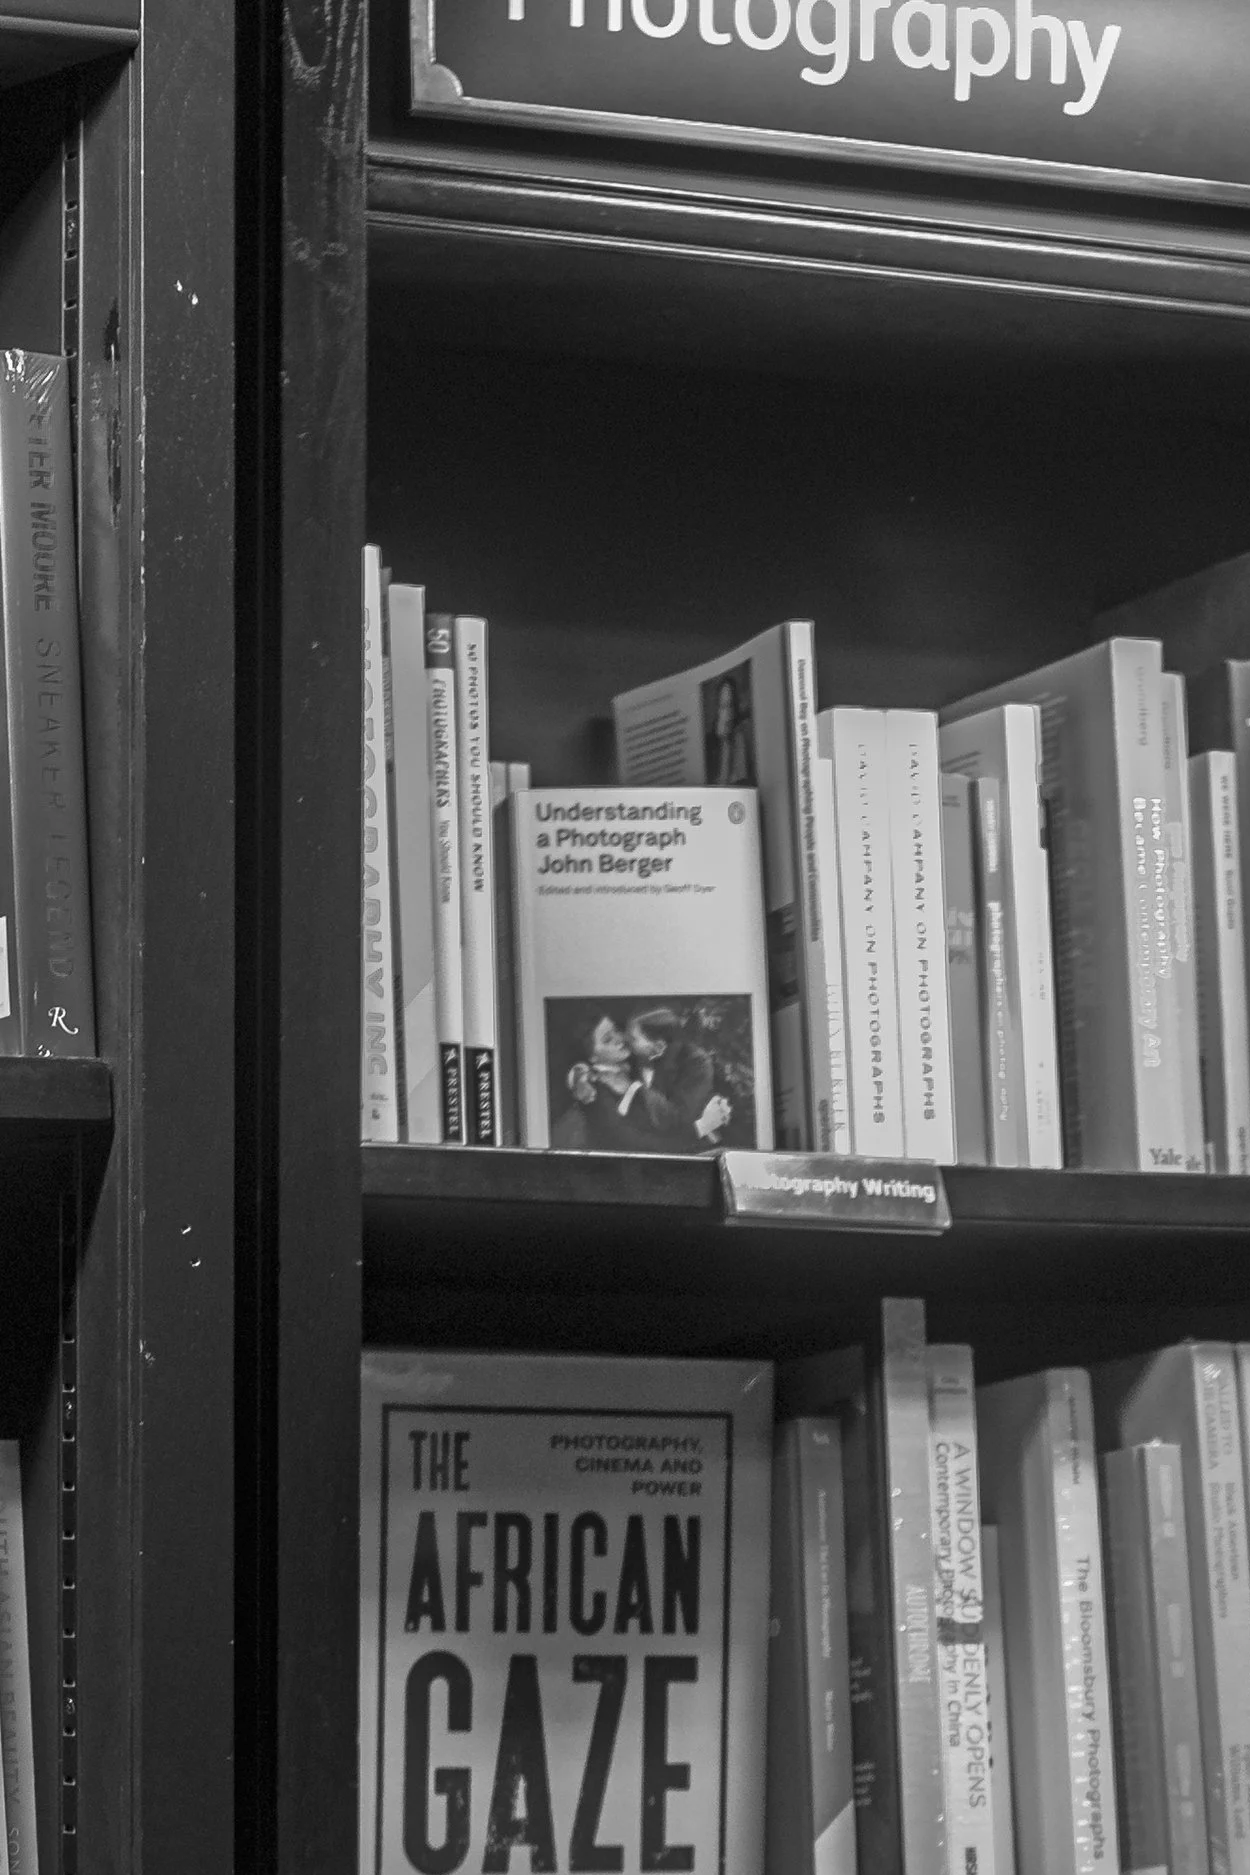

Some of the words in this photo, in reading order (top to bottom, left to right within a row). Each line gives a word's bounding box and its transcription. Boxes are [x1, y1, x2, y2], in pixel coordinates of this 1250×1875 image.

[507, 0, 1121, 115] otography
[30, 501, 57, 612] MOORE
[428, 628, 452, 653] 50
[468, 666, 480, 730] PHOTOS
[34, 638, 68, 809] SNEAKER
[470, 738, 481, 768] YOU
[471, 774, 483, 838] SHOULD
[535, 801, 703, 826] Understanding
[1150, 798, 1164, 841] How
[536, 833, 551, 849] a
[556, 828, 687, 852] Photograph
[472, 843, 485, 892] KNOW
[537, 854, 593, 874] John
[598, 854, 674, 878] Berger
[916, 921, 928, 950] ON
[1154, 849, 1172, 979] Photography
[865, 925, 878, 953] ON
[366, 1011, 388, 1076] INC
[867, 961, 886, 1124] PHOTOGRAPHS
[918, 958, 936, 1120] PHOTOGRAPHS
[1149, 1147, 1183, 1166] Yale
[862, 1178, 936, 1204] Writing
[408, 1430, 471, 1492] THE
[550, 1434, 703, 1454] PHOTOGRAPHY,
[574, 1456, 653, 1476] CINEMA
[660, 1459, 703, 1476] AND
[954, 1442, 972, 1459] A
[632, 1479, 703, 1497] POWER
[935, 1442, 955, 1563] Contemporary
[956, 1467, 977, 1579] WINDOW
[403, 1510, 700, 1637] AFRICAN
[1076, 1555, 1092, 1592] The
[1078, 1600, 1098, 1721] Bloomsbury
[948, 1680, 960, 1694] in
[947, 1700, 961, 1748] China
[966, 1724, 986, 1808] OPENS
[1086, 1729, 1107, 1860] Photographs
